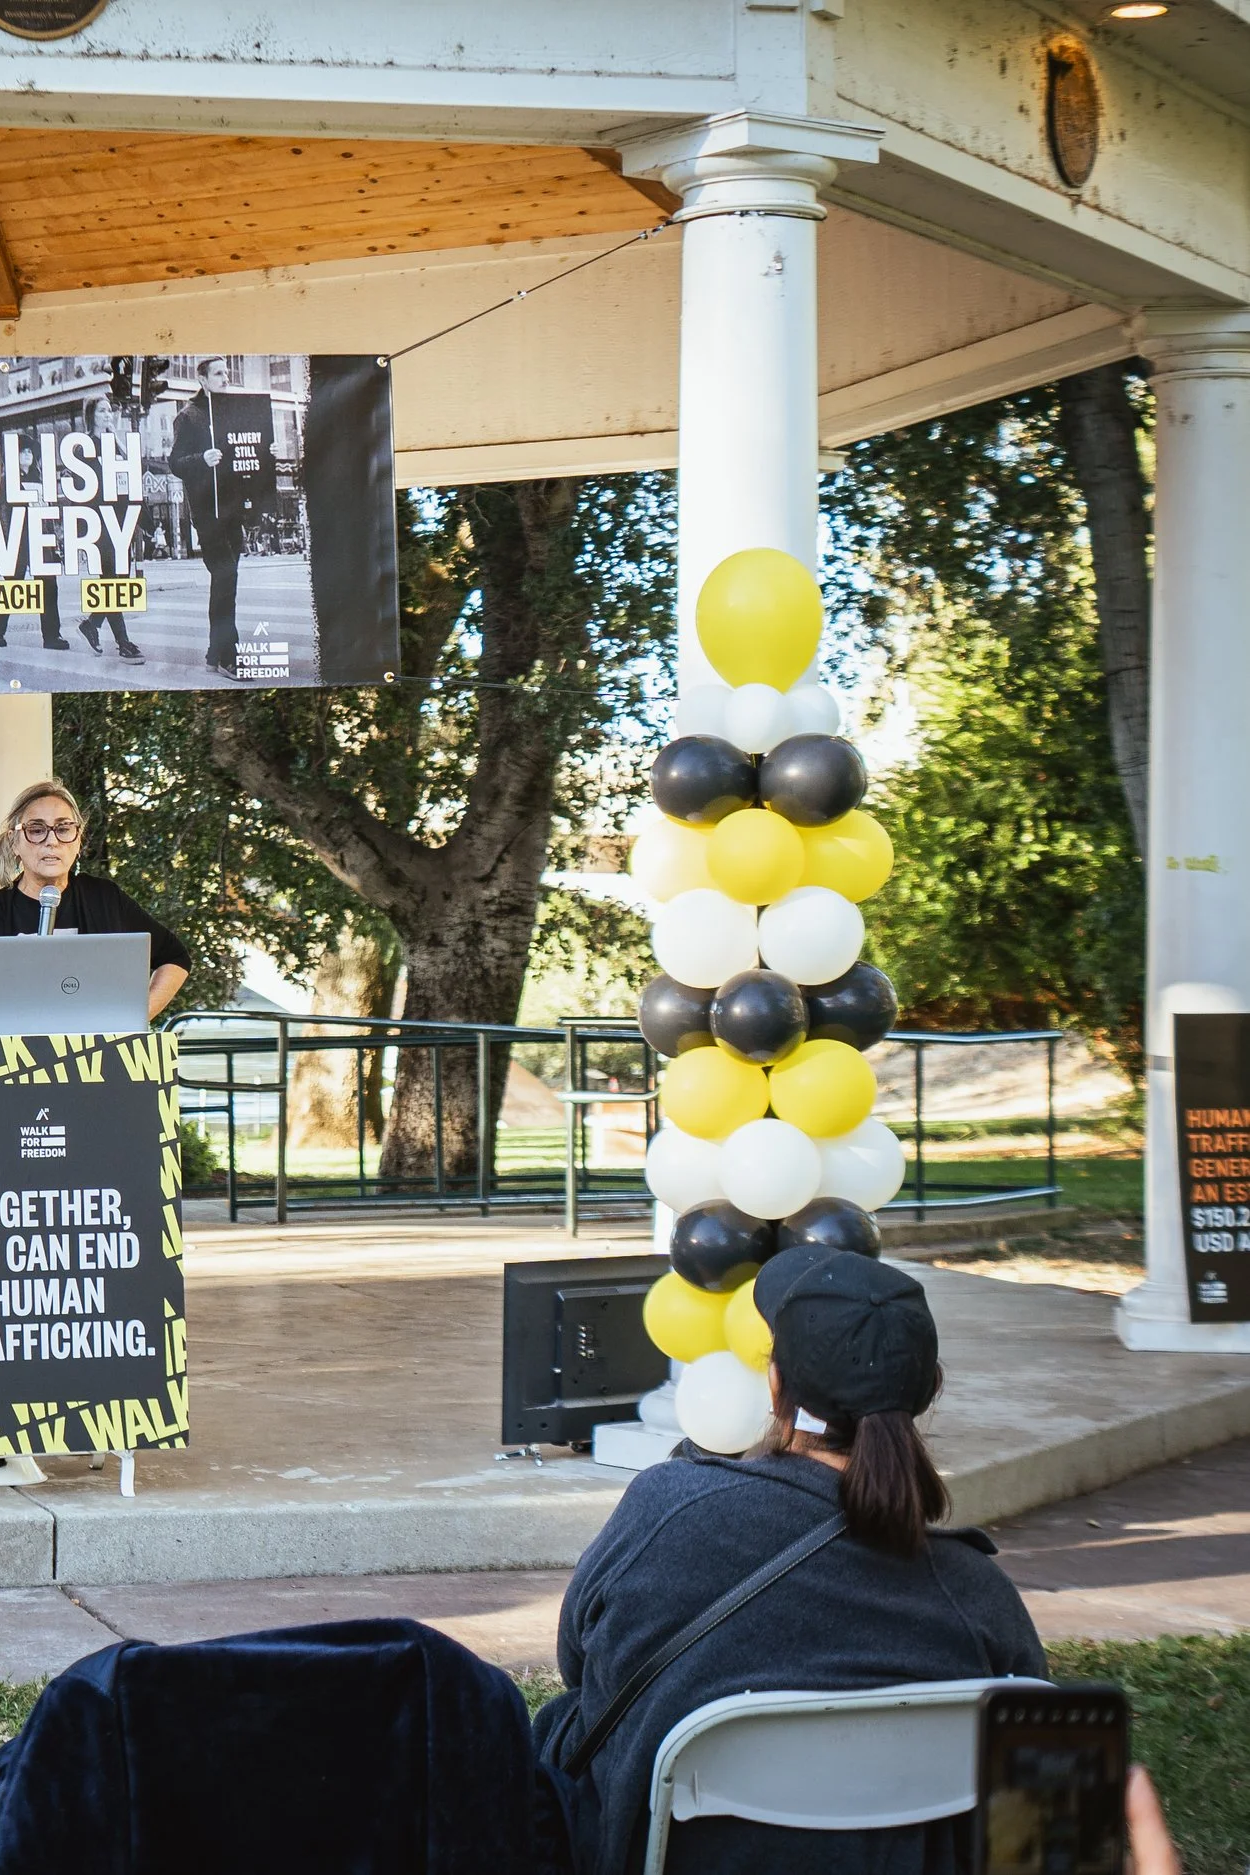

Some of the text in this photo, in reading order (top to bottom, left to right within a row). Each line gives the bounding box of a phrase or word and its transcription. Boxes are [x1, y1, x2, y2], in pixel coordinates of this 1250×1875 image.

[227, 432, 262, 444] SLAVERY
[235, 446, 257, 458] STILL
[233, 460, 260, 471] EXISTS
[86, 582, 143, 608] STEP
[235, 643, 268, 653] WALK
[236, 656, 259, 666] FOR
[236, 667, 289, 678] FREEDOM
[20, 1126, 49, 1136] WALK
[21, 1137, 40, 1147] FOR
[21, 1148, 66, 1158] FREEDOM
[1191, 1183, 1220, 1202] AN
[1193, 1231, 1235, 1253] USD
[6, 1233, 71, 1273] CAN
[78, 1232, 140, 1270] END
